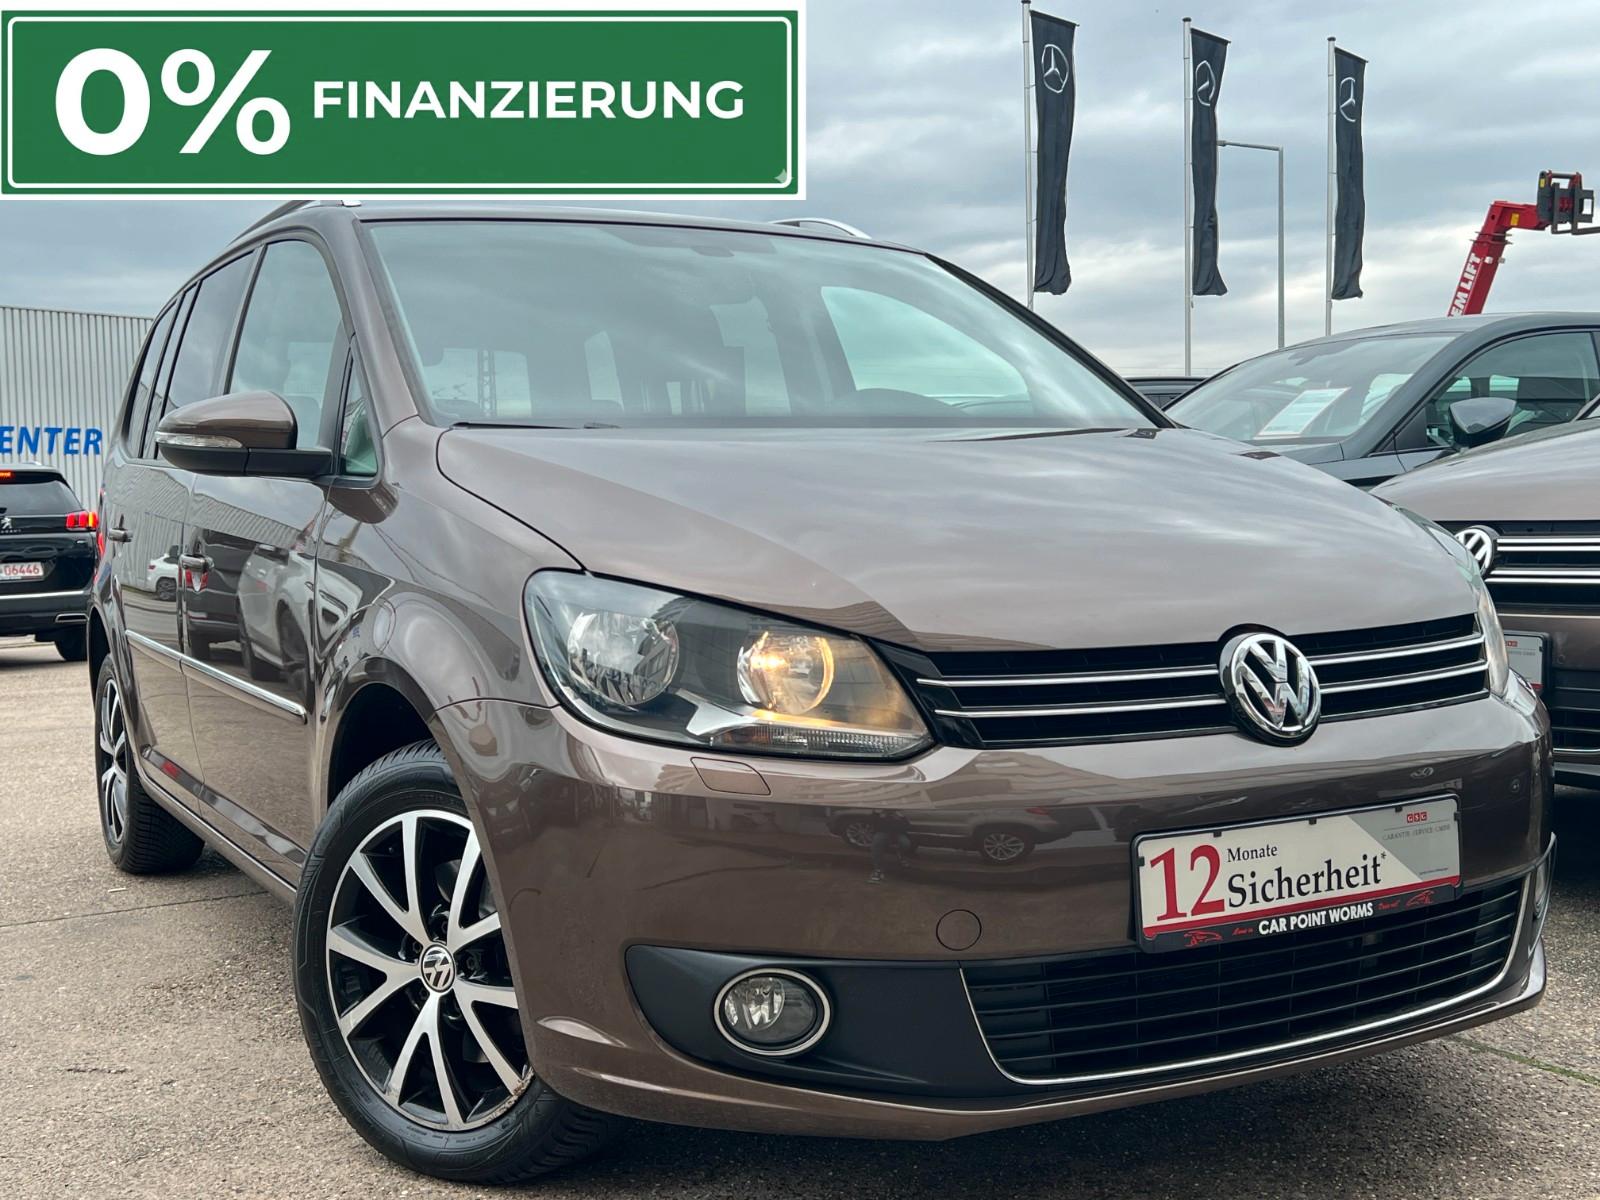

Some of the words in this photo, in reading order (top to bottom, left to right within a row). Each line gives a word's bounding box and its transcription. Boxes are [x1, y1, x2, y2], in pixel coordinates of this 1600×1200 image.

[1460, 252, 1481, 290] LIFT
[0, 426, 103, 455] ENTER
[1227, 844, 1278, 863] Monate
[1150, 844, 1225, 921] 12
[1258, 918, 1287, 935] CAR
[1290, 911, 1327, 930] POINT
[1329, 902, 1374, 924] WORMS
